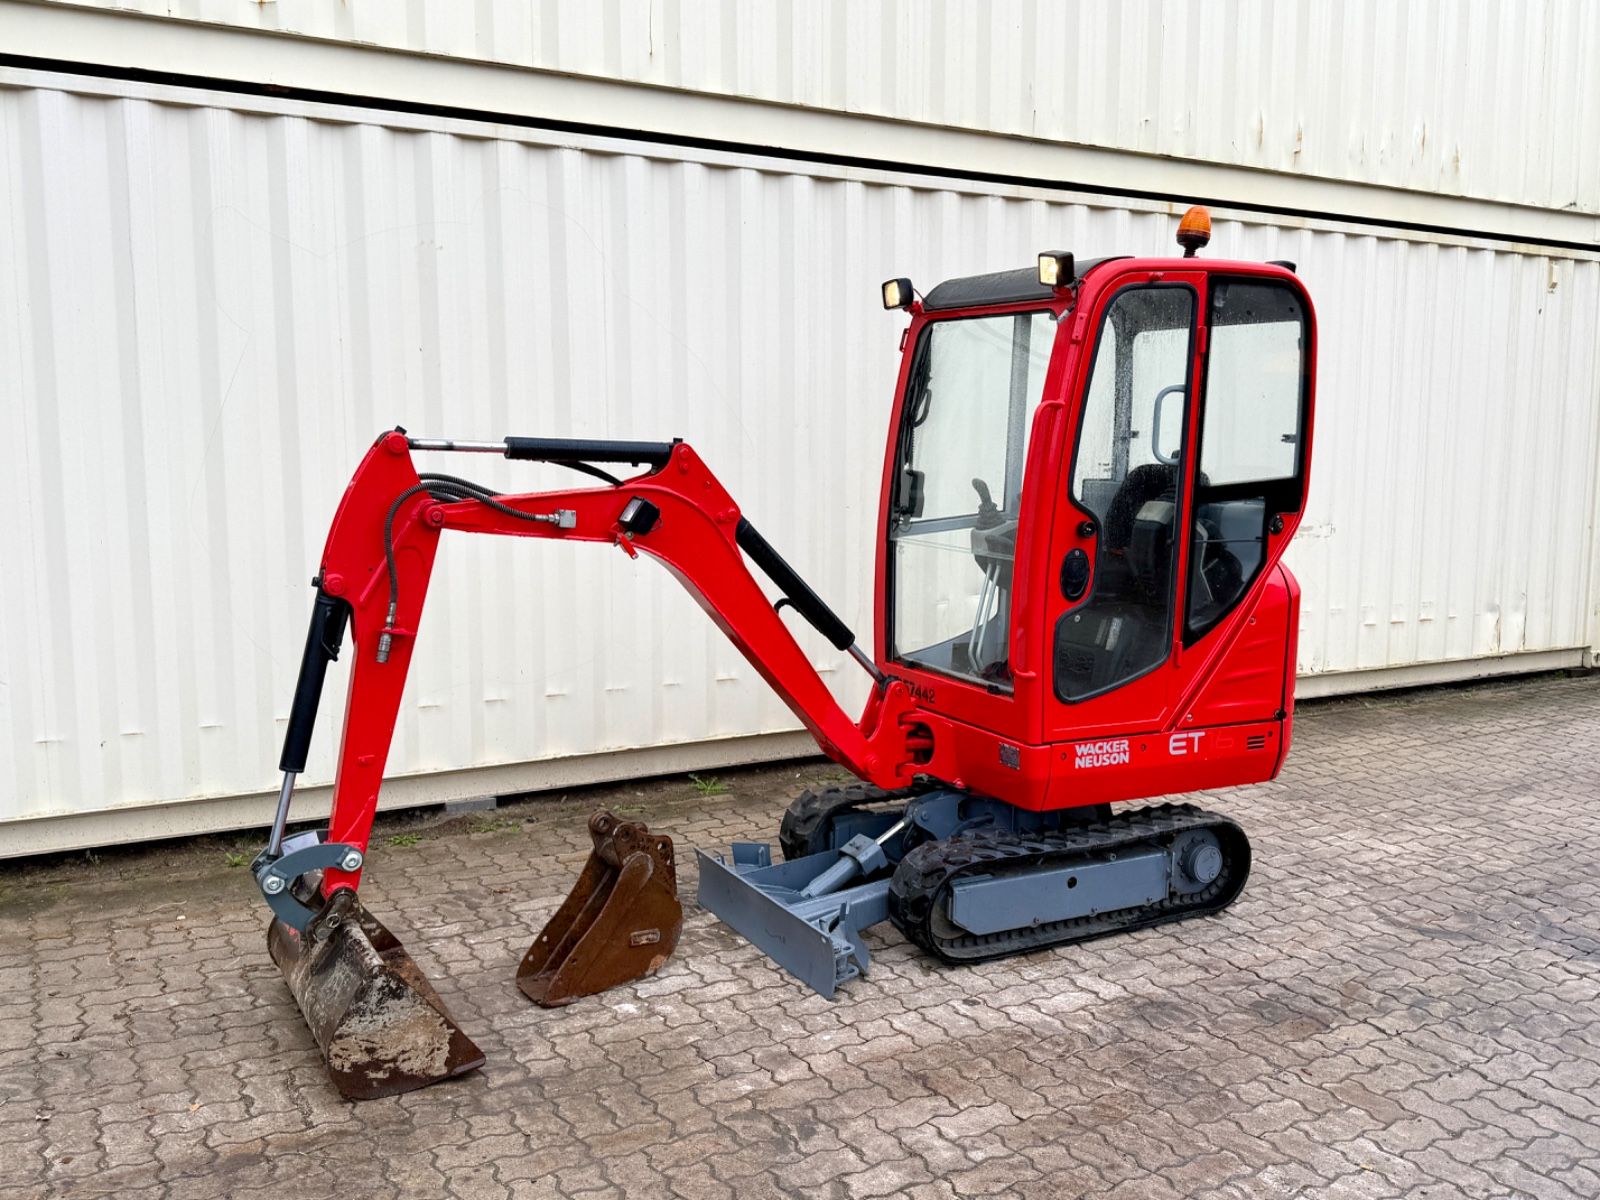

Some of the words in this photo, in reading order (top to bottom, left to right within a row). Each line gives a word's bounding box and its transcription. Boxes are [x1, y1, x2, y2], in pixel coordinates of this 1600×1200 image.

[1075, 740, 1129, 756] WACKER
[1169, 731, 1206, 755] ET
[1075, 752, 1130, 769] NEUSON
